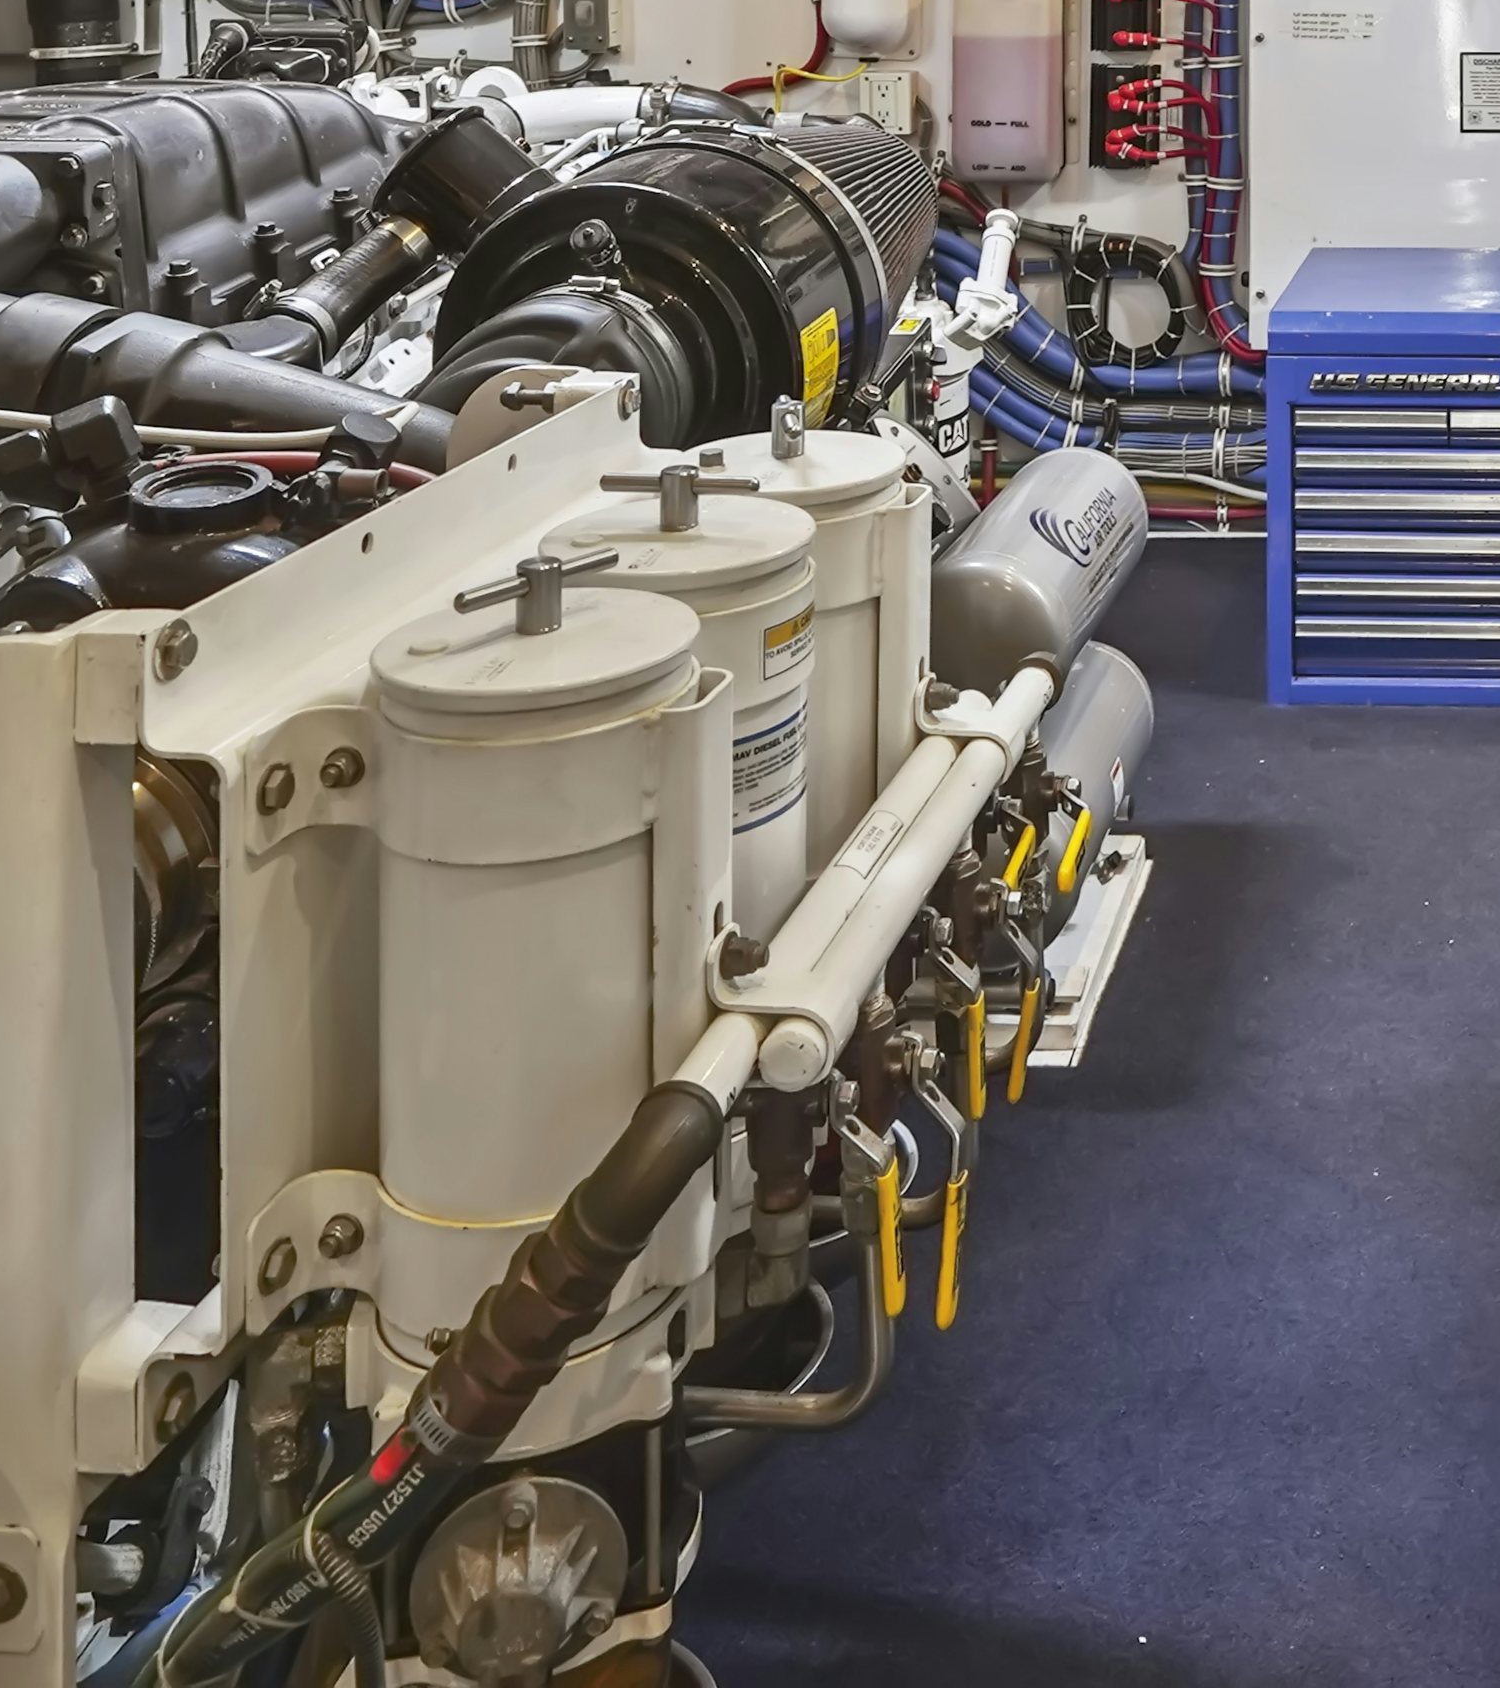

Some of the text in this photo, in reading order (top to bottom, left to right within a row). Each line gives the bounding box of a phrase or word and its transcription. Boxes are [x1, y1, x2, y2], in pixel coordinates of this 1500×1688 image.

[1010, 120, 1029, 128] FULL
[937, 413, 969, 454] CAT
[1064, 486, 1117, 556] CALIFORNIA
[765, 650, 774, 659] TO
[754, 737, 782, 755] DIESEL
[381, 1462, 425, 1516] J1527
